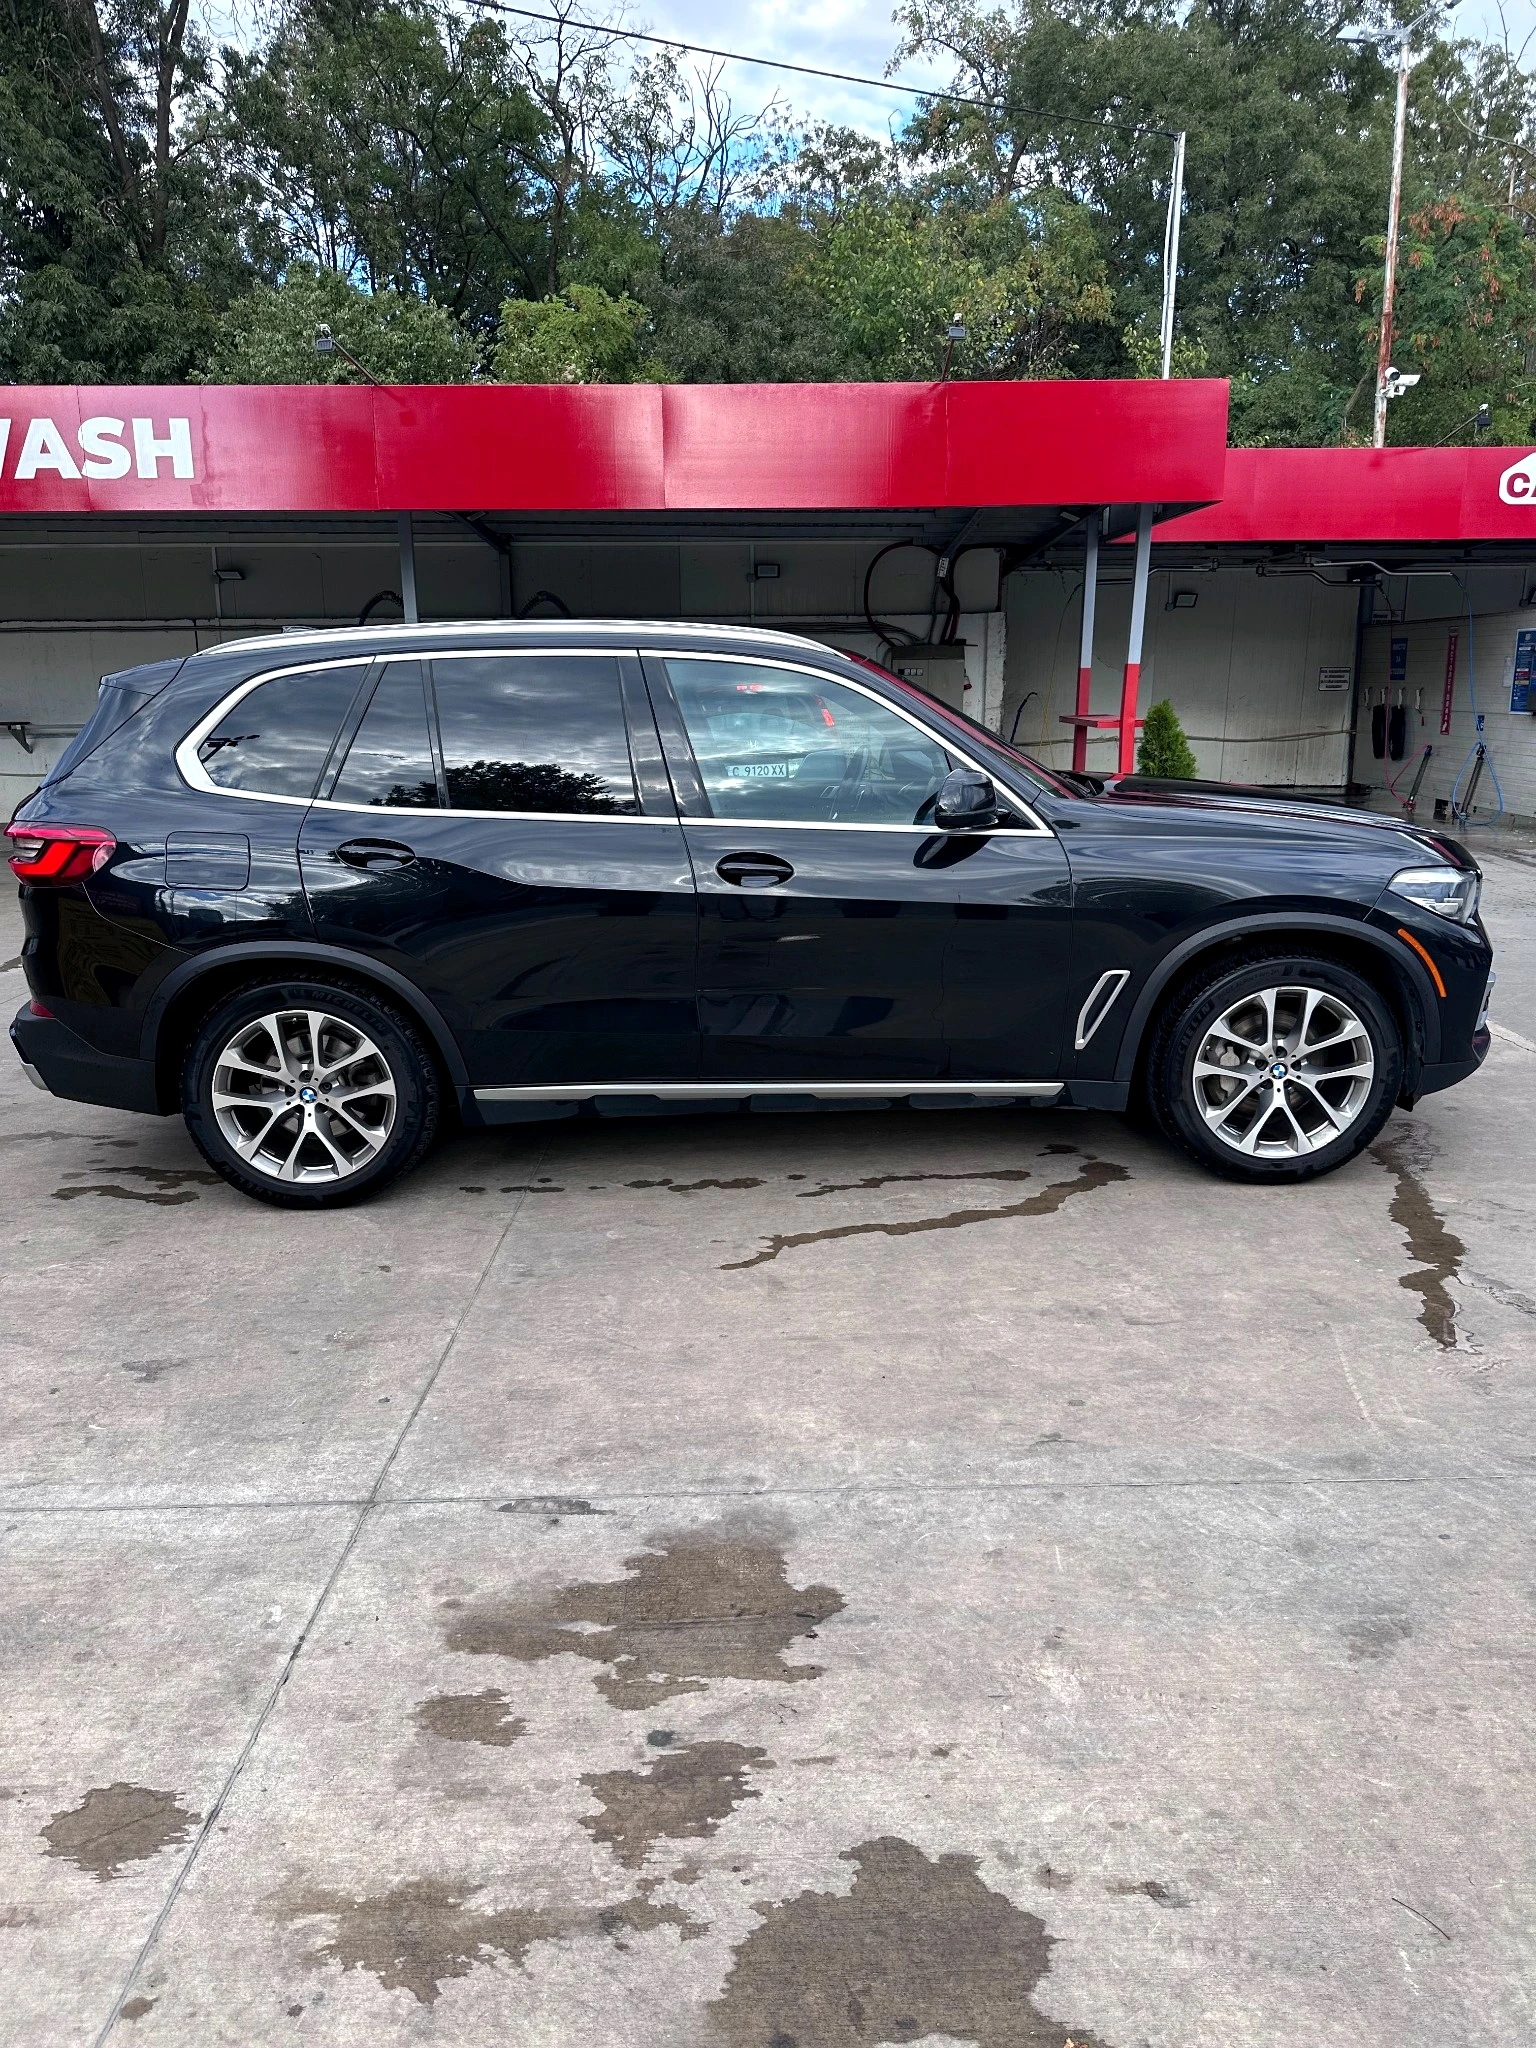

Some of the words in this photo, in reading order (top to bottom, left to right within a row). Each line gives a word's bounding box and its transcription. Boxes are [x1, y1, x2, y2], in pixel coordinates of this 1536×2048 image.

[0, 416, 195, 480] ASH
[1506, 472, 1536, 498] C
[732, 766, 739, 777] C
[744, 765, 769, 777] 9120
[771, 764, 785, 776] XX
